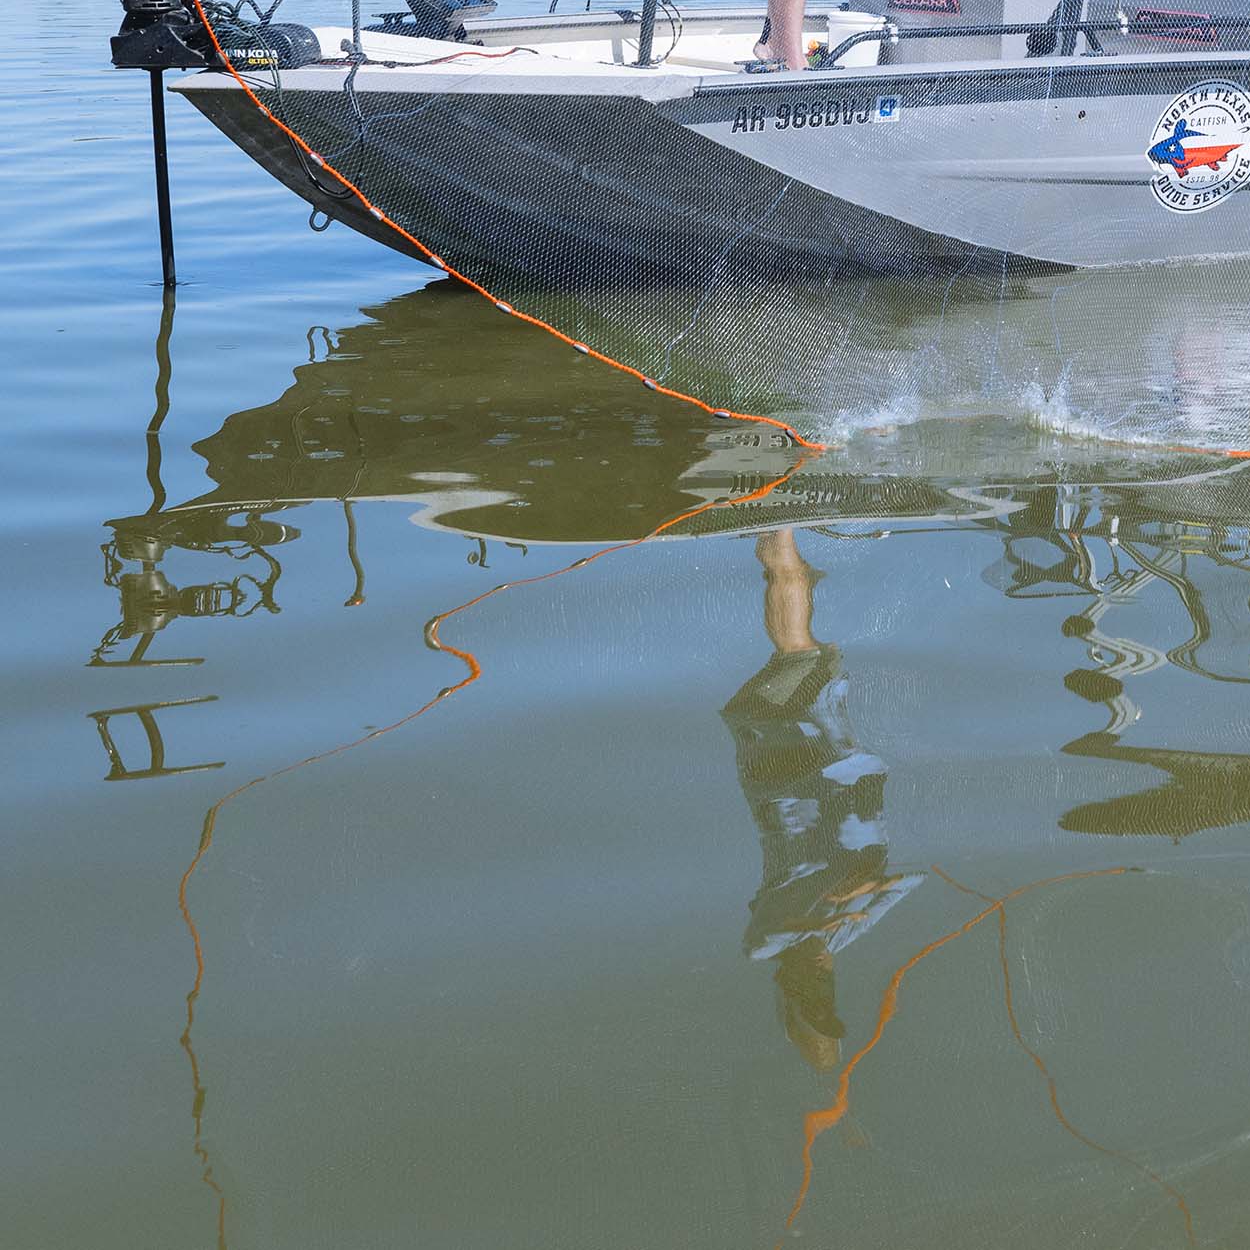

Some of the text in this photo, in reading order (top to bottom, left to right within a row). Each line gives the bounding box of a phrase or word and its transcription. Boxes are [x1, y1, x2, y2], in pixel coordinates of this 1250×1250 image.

[731, 105, 767, 134] AR
[1162, 88, 1250, 132] NORTH TEXAS
[1190, 116, 1227, 127] CATFISH
[1157, 158, 1250, 206] GUIDE SERVICE
